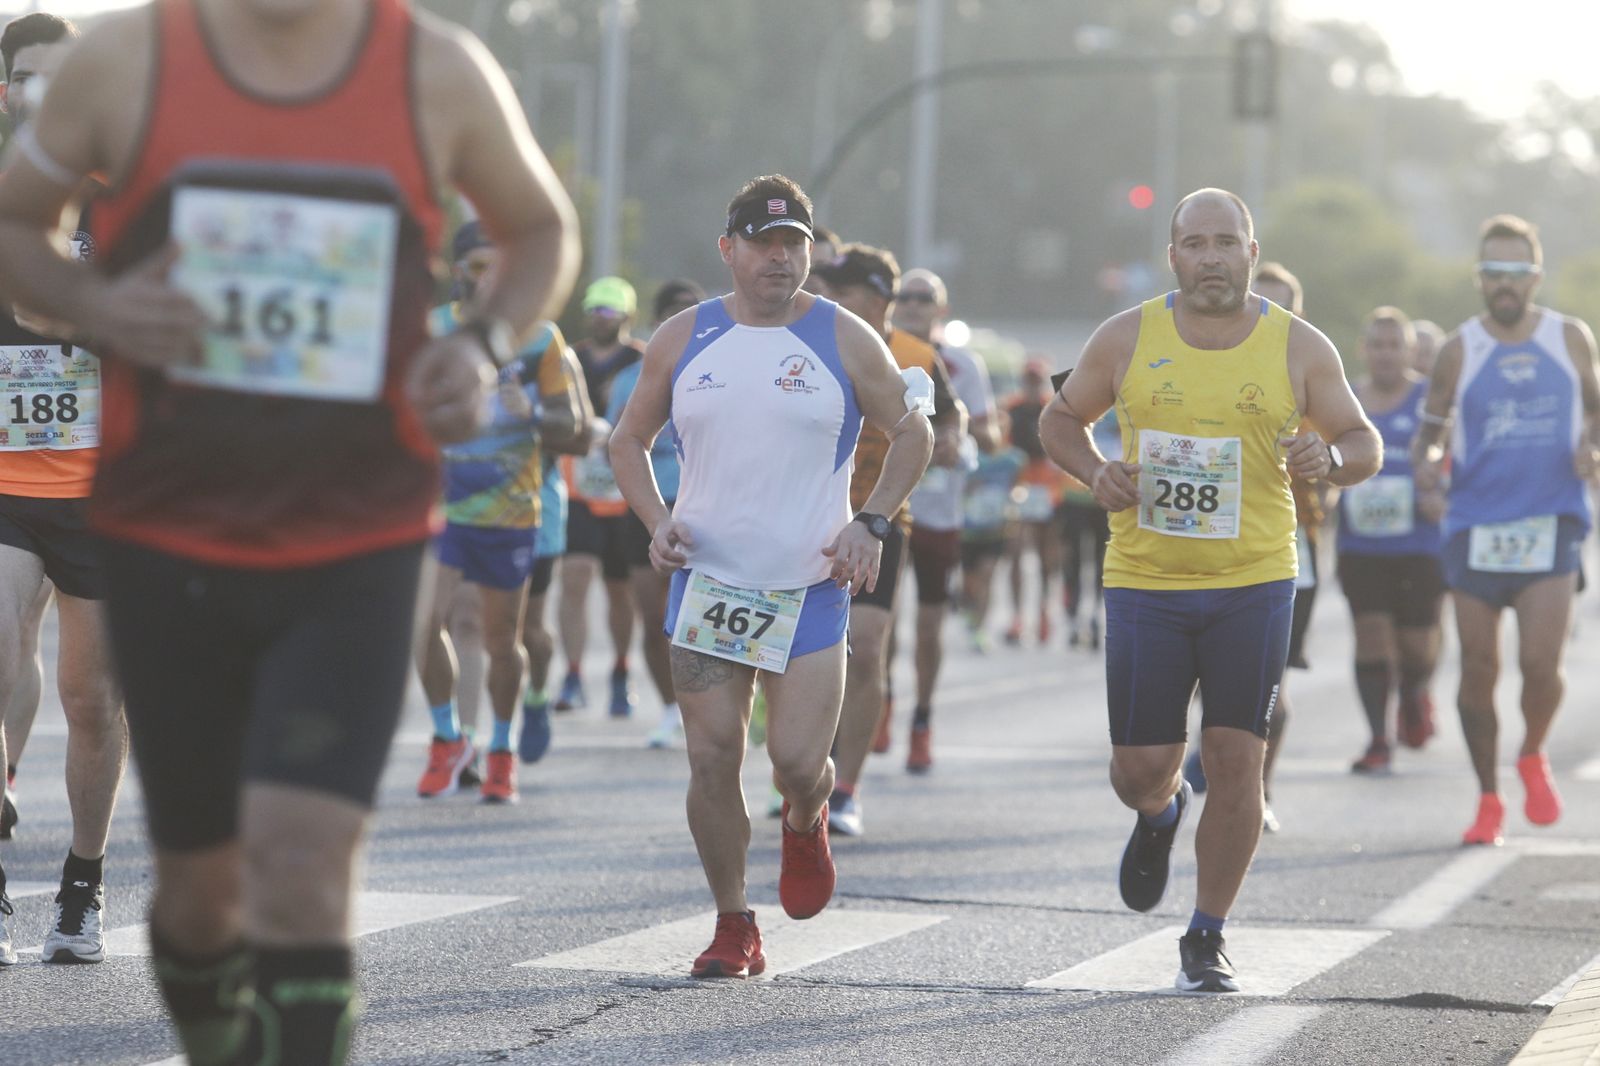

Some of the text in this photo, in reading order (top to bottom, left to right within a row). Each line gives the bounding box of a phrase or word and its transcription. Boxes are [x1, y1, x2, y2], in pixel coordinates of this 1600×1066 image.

[216, 285, 334, 346] 161
[10, 393, 79, 424] 188
[1154, 479, 1219, 513] 288
[703, 601, 776, 640] 467
